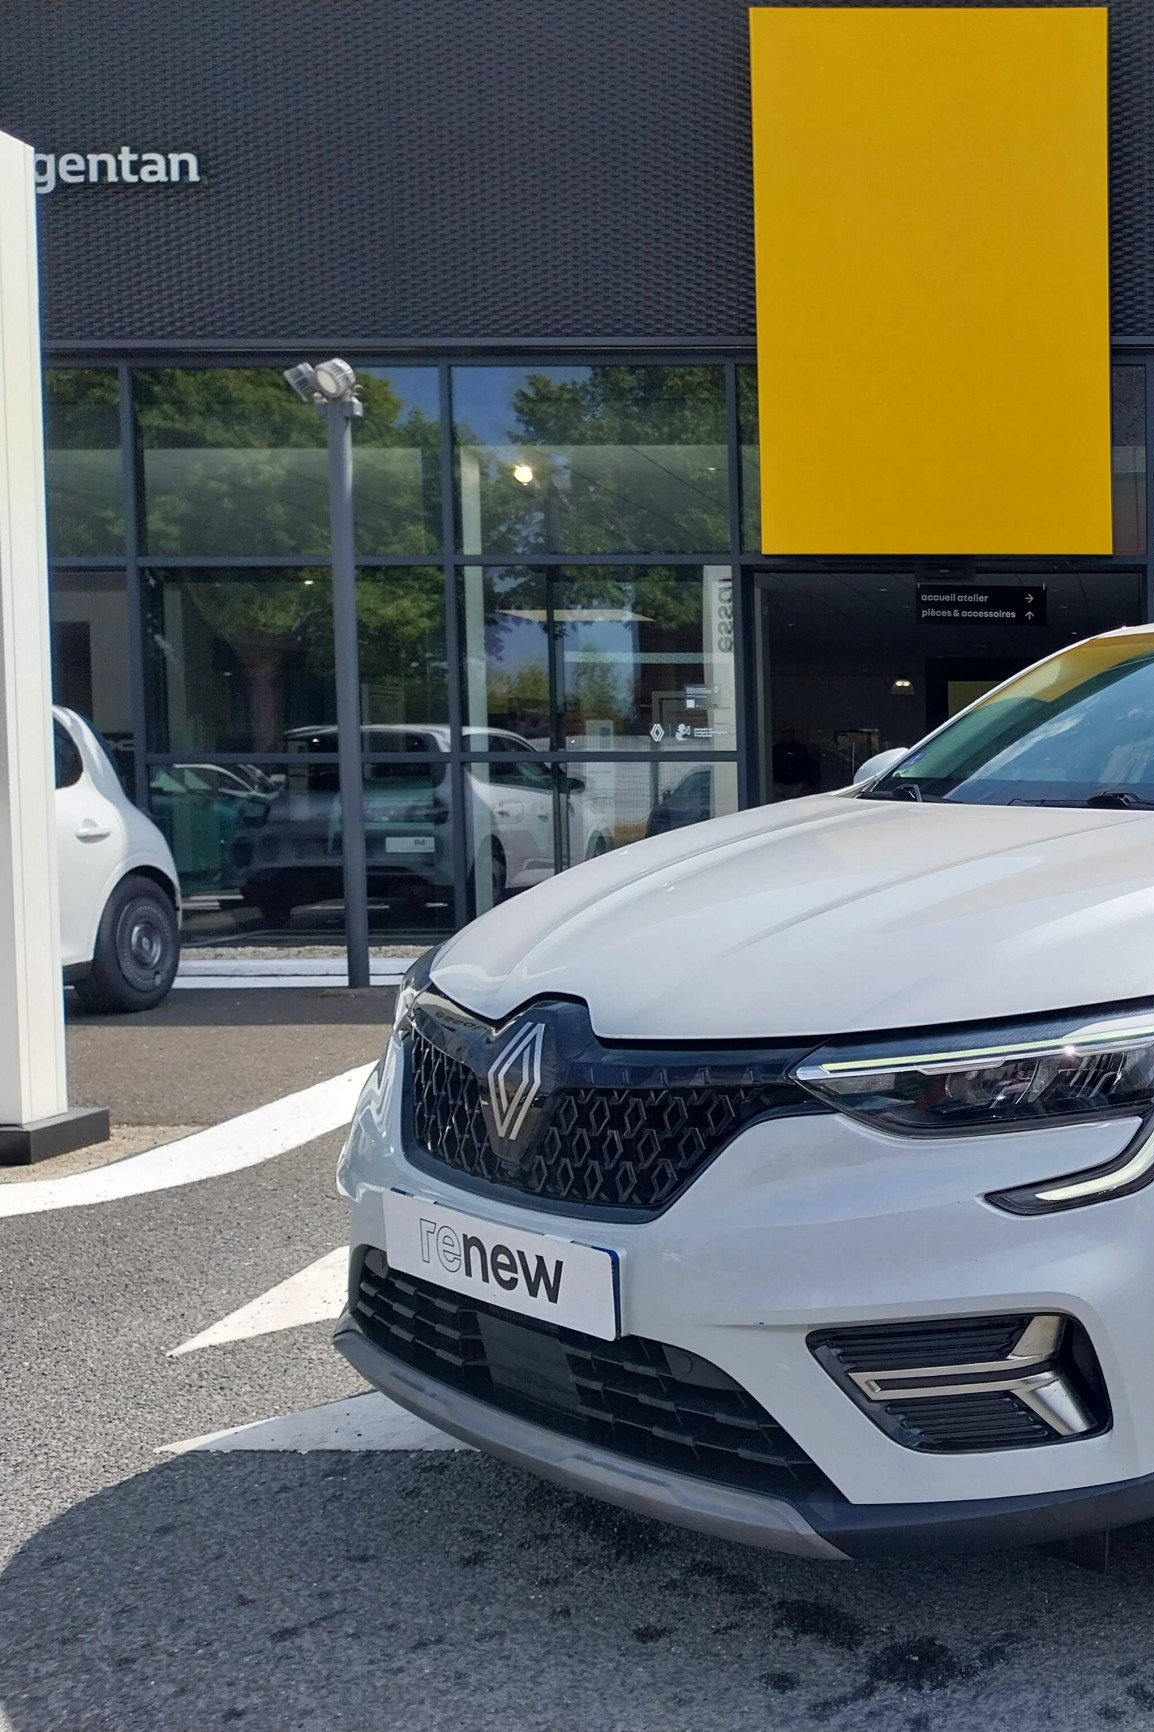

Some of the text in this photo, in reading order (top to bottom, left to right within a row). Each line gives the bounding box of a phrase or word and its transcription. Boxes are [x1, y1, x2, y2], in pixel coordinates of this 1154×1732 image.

[35, 146, 200, 194] gentan
[921, 593, 989, 602] accueil atelier
[921, 608, 1016, 618] pièces & accessoires
[420, 1218, 564, 1304] renew
